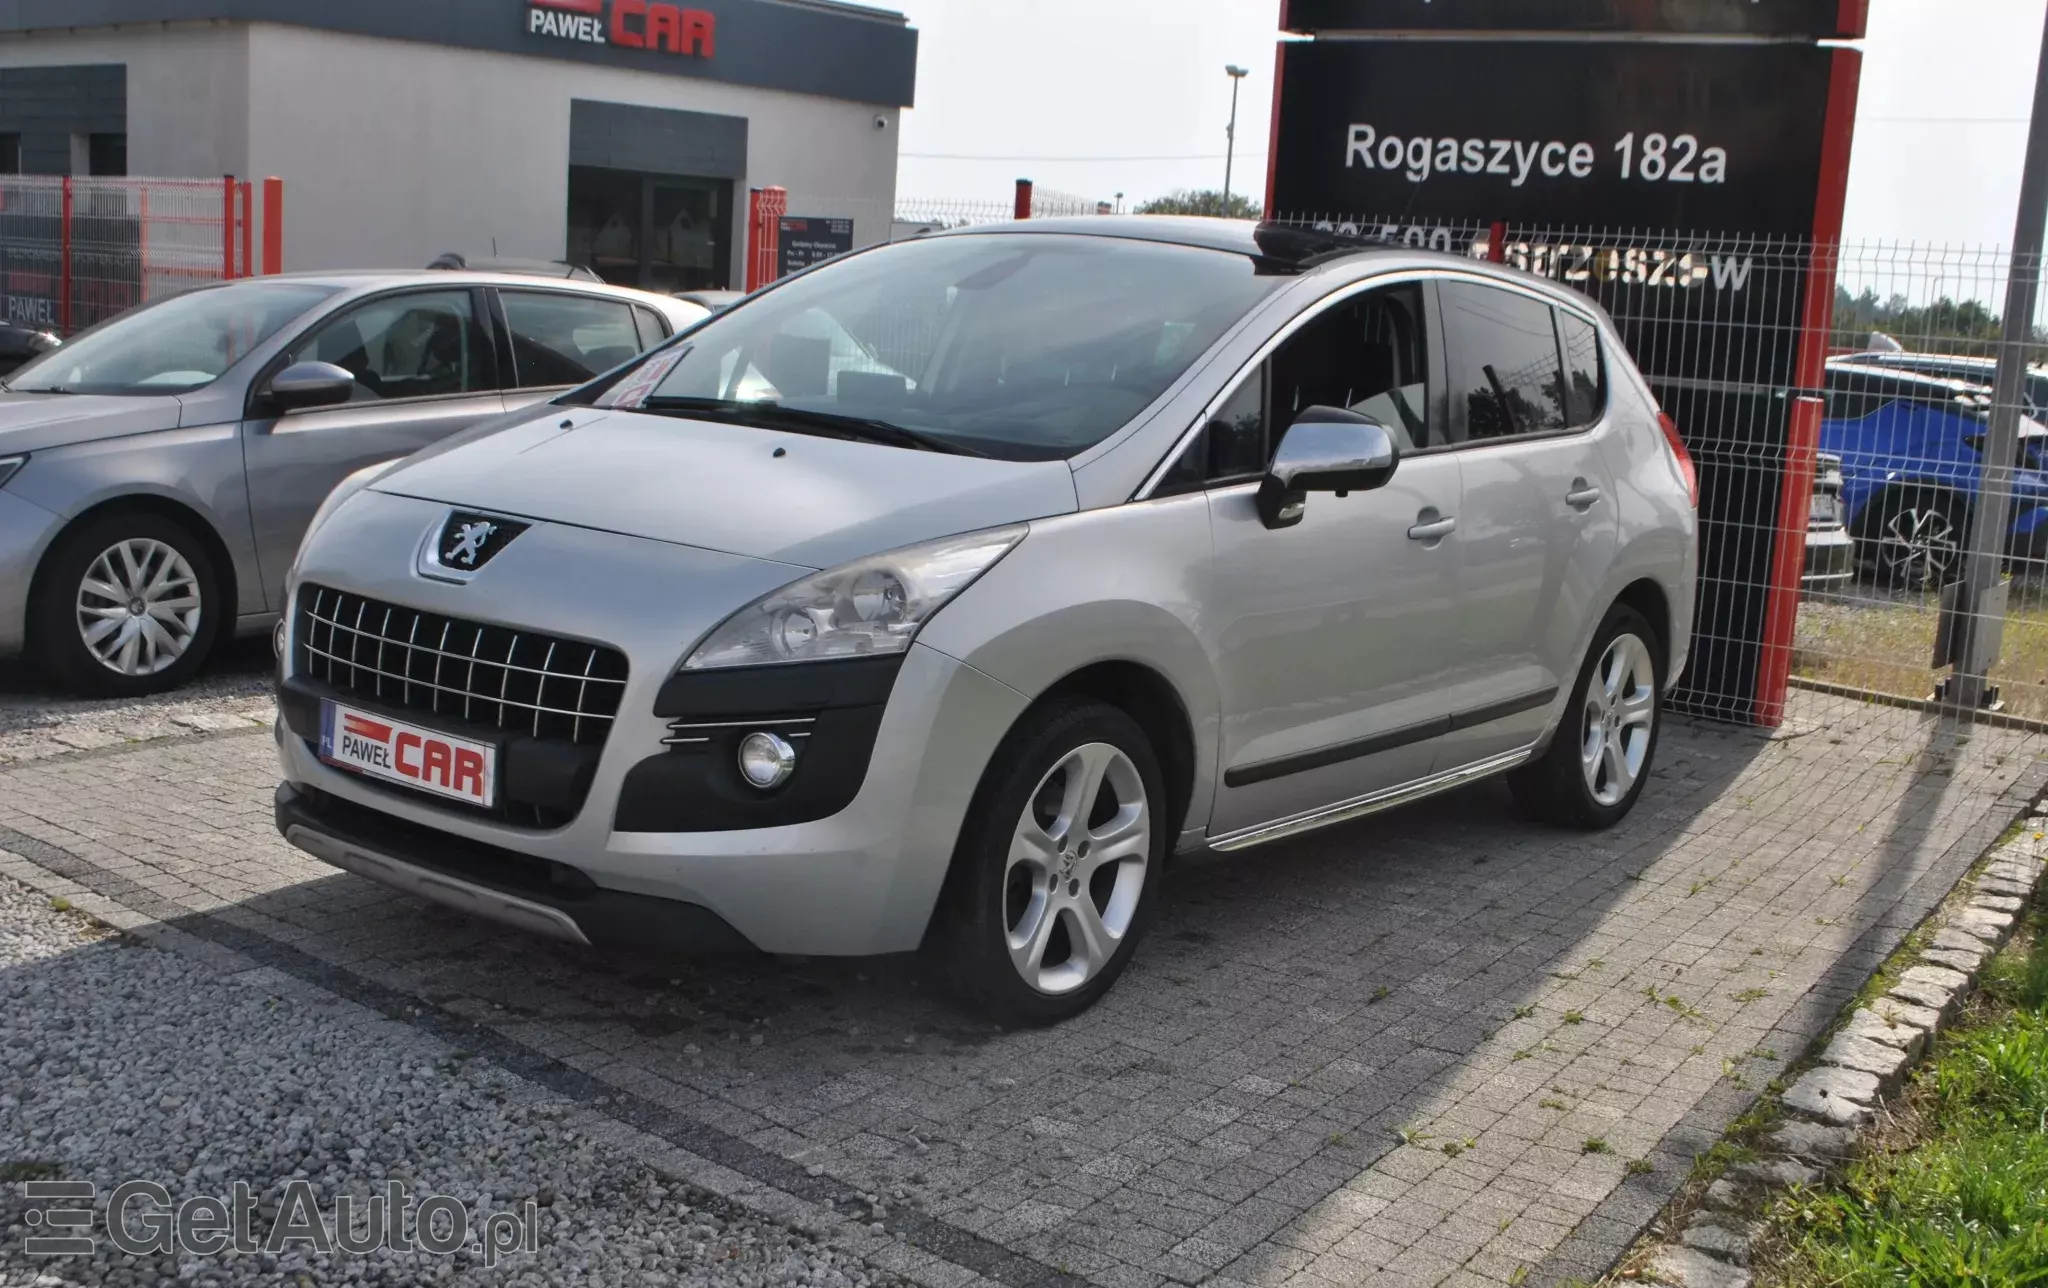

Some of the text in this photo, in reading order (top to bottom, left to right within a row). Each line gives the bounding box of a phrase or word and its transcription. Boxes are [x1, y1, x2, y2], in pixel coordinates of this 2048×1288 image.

[530, 0, 716, 59] PAWEŁ CAR
[1345, 123, 1727, 186] Rogaszyce 182a
[342, 731, 484, 797] PAWEŁ CAR
